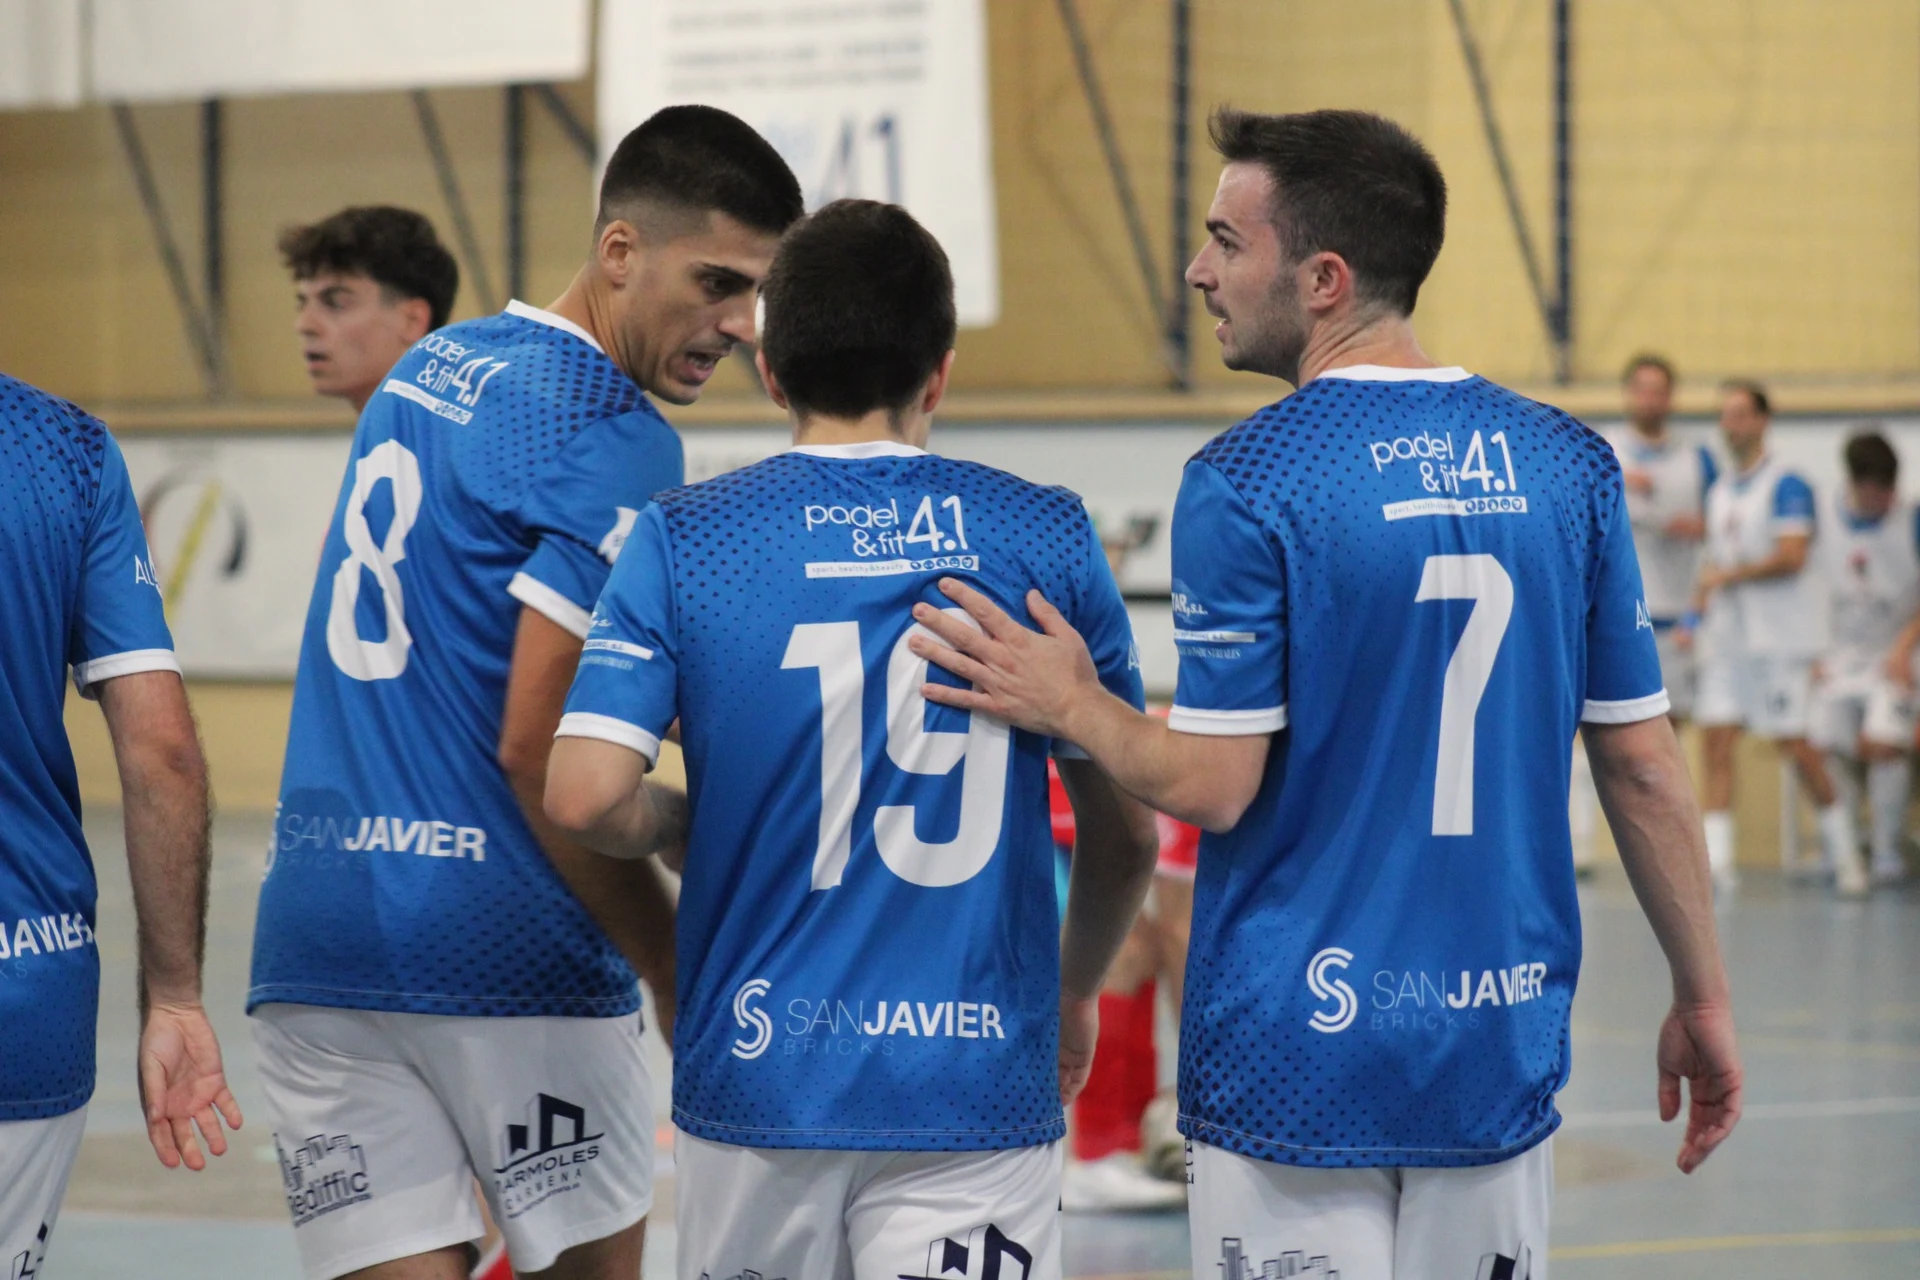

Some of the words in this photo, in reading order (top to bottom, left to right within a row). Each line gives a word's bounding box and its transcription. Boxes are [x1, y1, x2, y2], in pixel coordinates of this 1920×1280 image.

[1370, 430, 1454, 473] padel
[1460, 430, 1517, 492] 4.1
[805, 498, 899, 532] padel
[905, 495, 969, 553] 4.1
[327, 439, 423, 681] 8
[852, 529, 905, 557] &fit
[1414, 553, 1514, 836] 7
[780, 608, 1010, 893] 19
[1371, 1012, 1481, 1031] BRICKS
[784, 1038, 895, 1056] BRICKS
